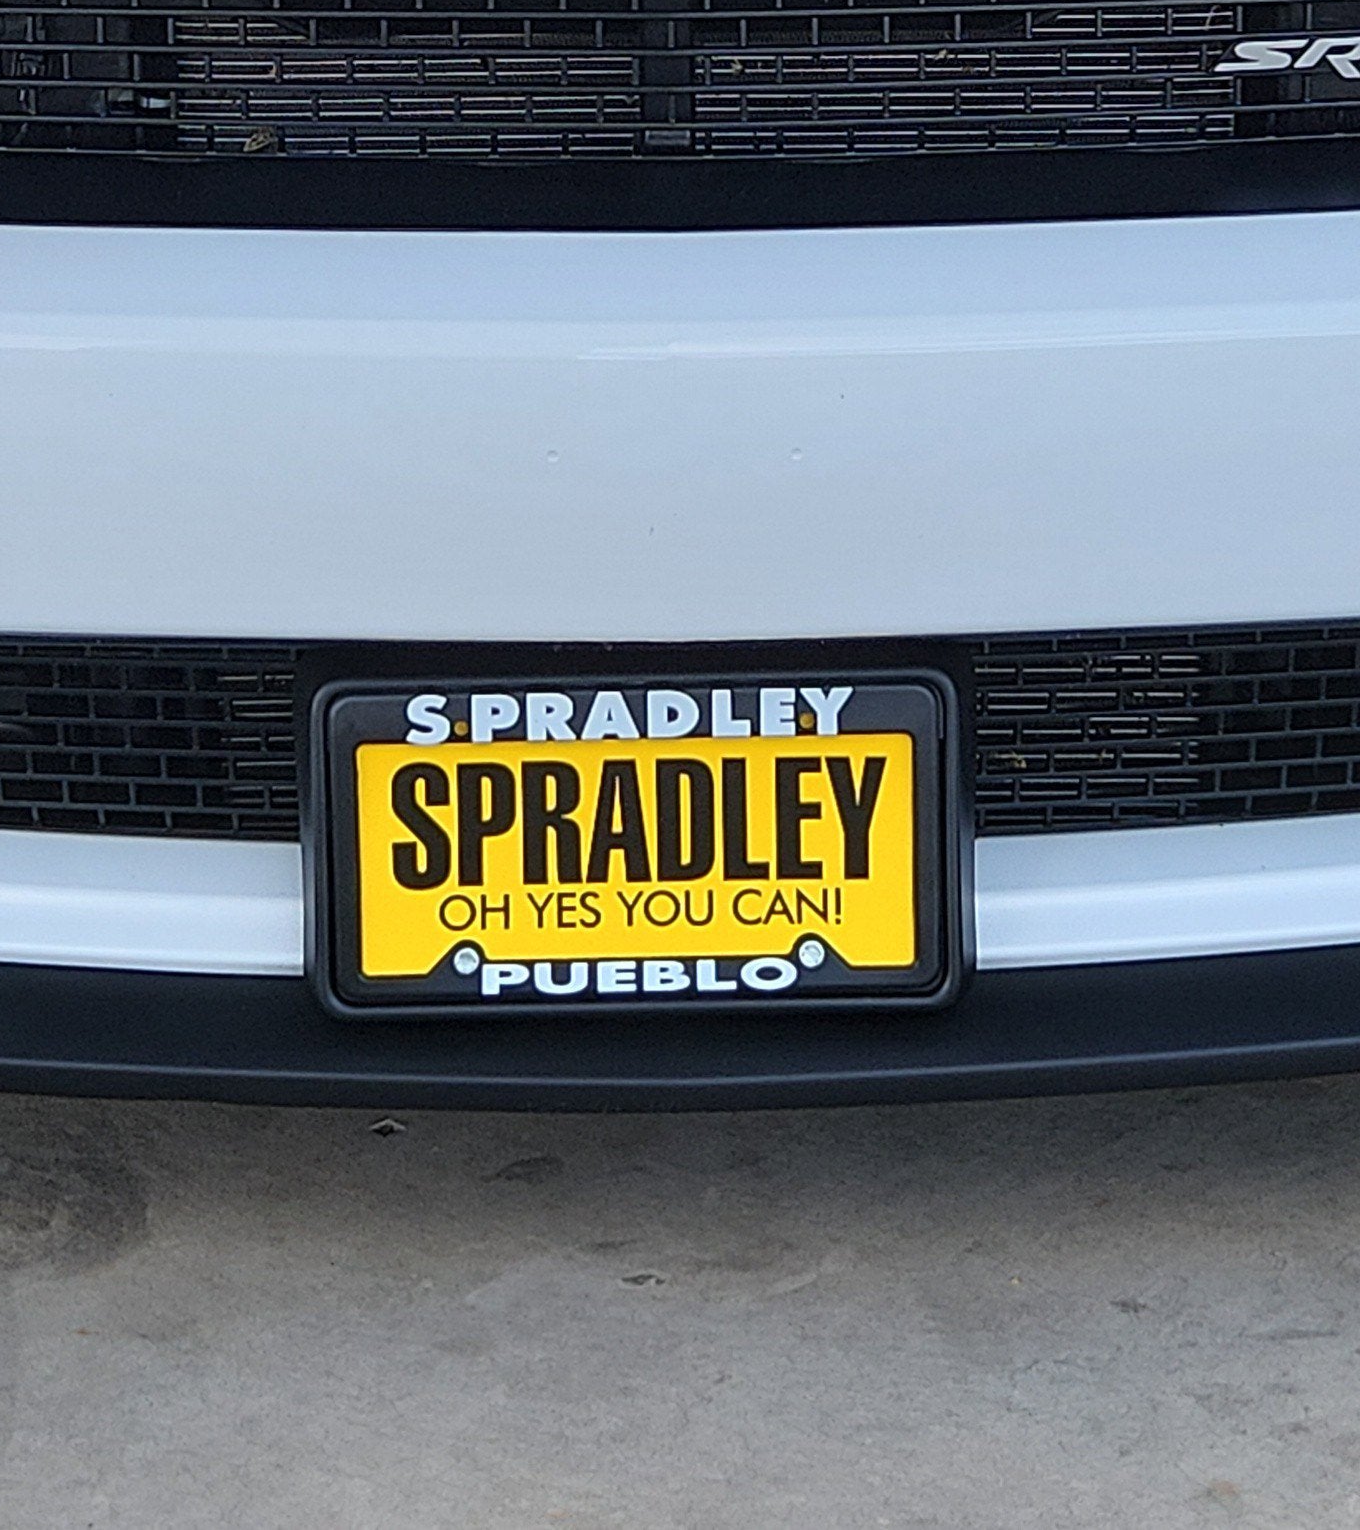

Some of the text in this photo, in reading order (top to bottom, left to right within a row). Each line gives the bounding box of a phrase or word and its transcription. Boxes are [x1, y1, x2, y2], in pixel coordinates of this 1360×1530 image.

[405, 686, 854, 745] SPRADLEY
[390, 755, 889, 890] SPRADLEY
[439, 887, 842, 931] OH YES YOU CAN!
[480, 957, 798, 995] PUEBLO
